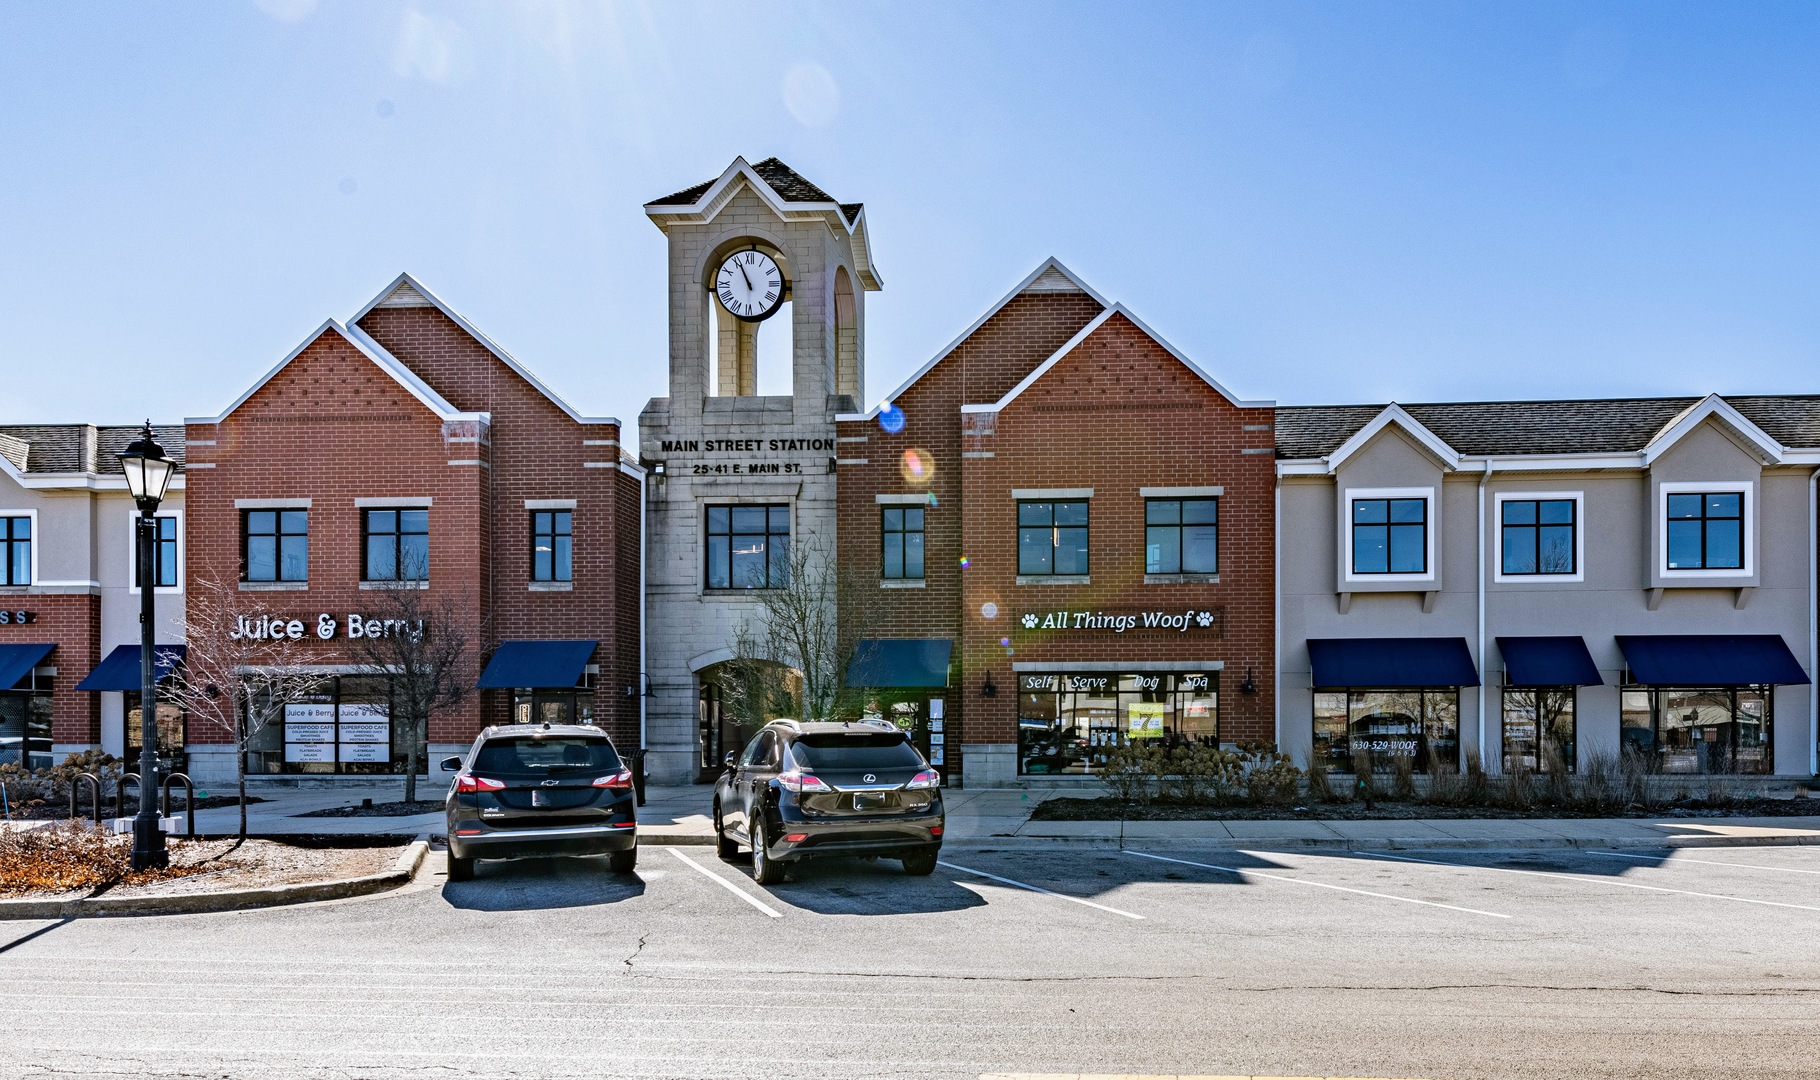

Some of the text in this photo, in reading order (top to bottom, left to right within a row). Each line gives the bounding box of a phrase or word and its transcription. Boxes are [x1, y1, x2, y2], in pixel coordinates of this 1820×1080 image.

[745, 252, 755, 265] XII
[661, 438, 834, 452] MAIN STREET STATION
[693, 463, 803, 474] 25-41 E. MAIN ST.
[1041, 610, 1195, 633] All Things Woof
[230, 613, 424, 644] Juice & Berry
[1026, 675, 1209, 691] Self Serve Dog Spa
[286, 709, 306, 717] Juice
[315, 709, 335, 718] Berry
[340, 709, 359, 717] Juice
[1139, 712, 1153, 731] 7
[1352, 740, 1418, 750] 630-529-WOOF
